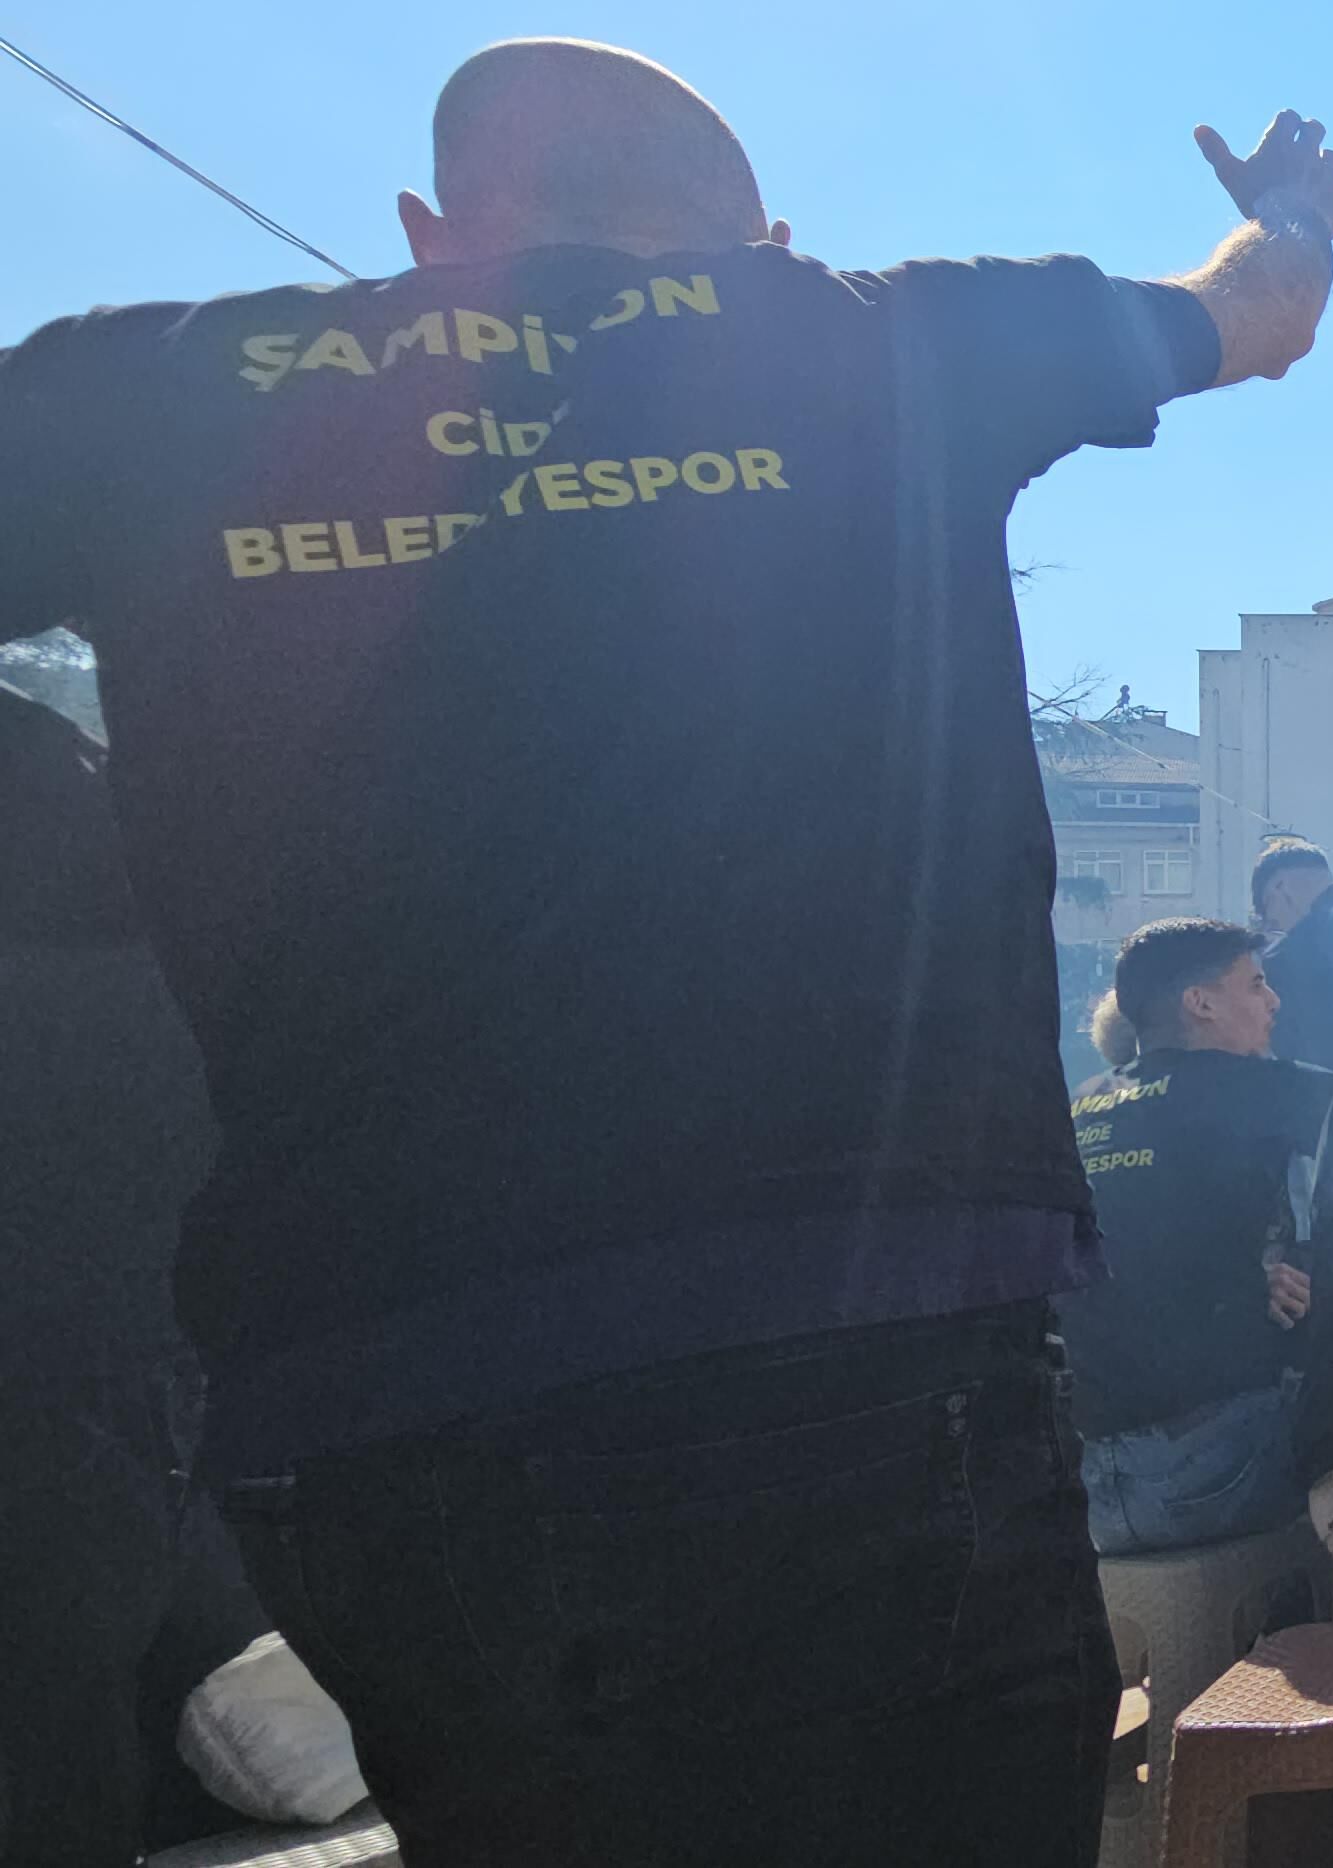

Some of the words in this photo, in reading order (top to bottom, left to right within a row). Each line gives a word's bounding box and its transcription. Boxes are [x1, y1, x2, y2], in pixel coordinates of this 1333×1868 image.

[239, 275, 721, 391] ŞAMPİON
[426, 402, 569, 457] CİD
[223, 447, 790, 579] BELEDYESPOR
[1071, 1075, 1171, 1119] AMPİYON
